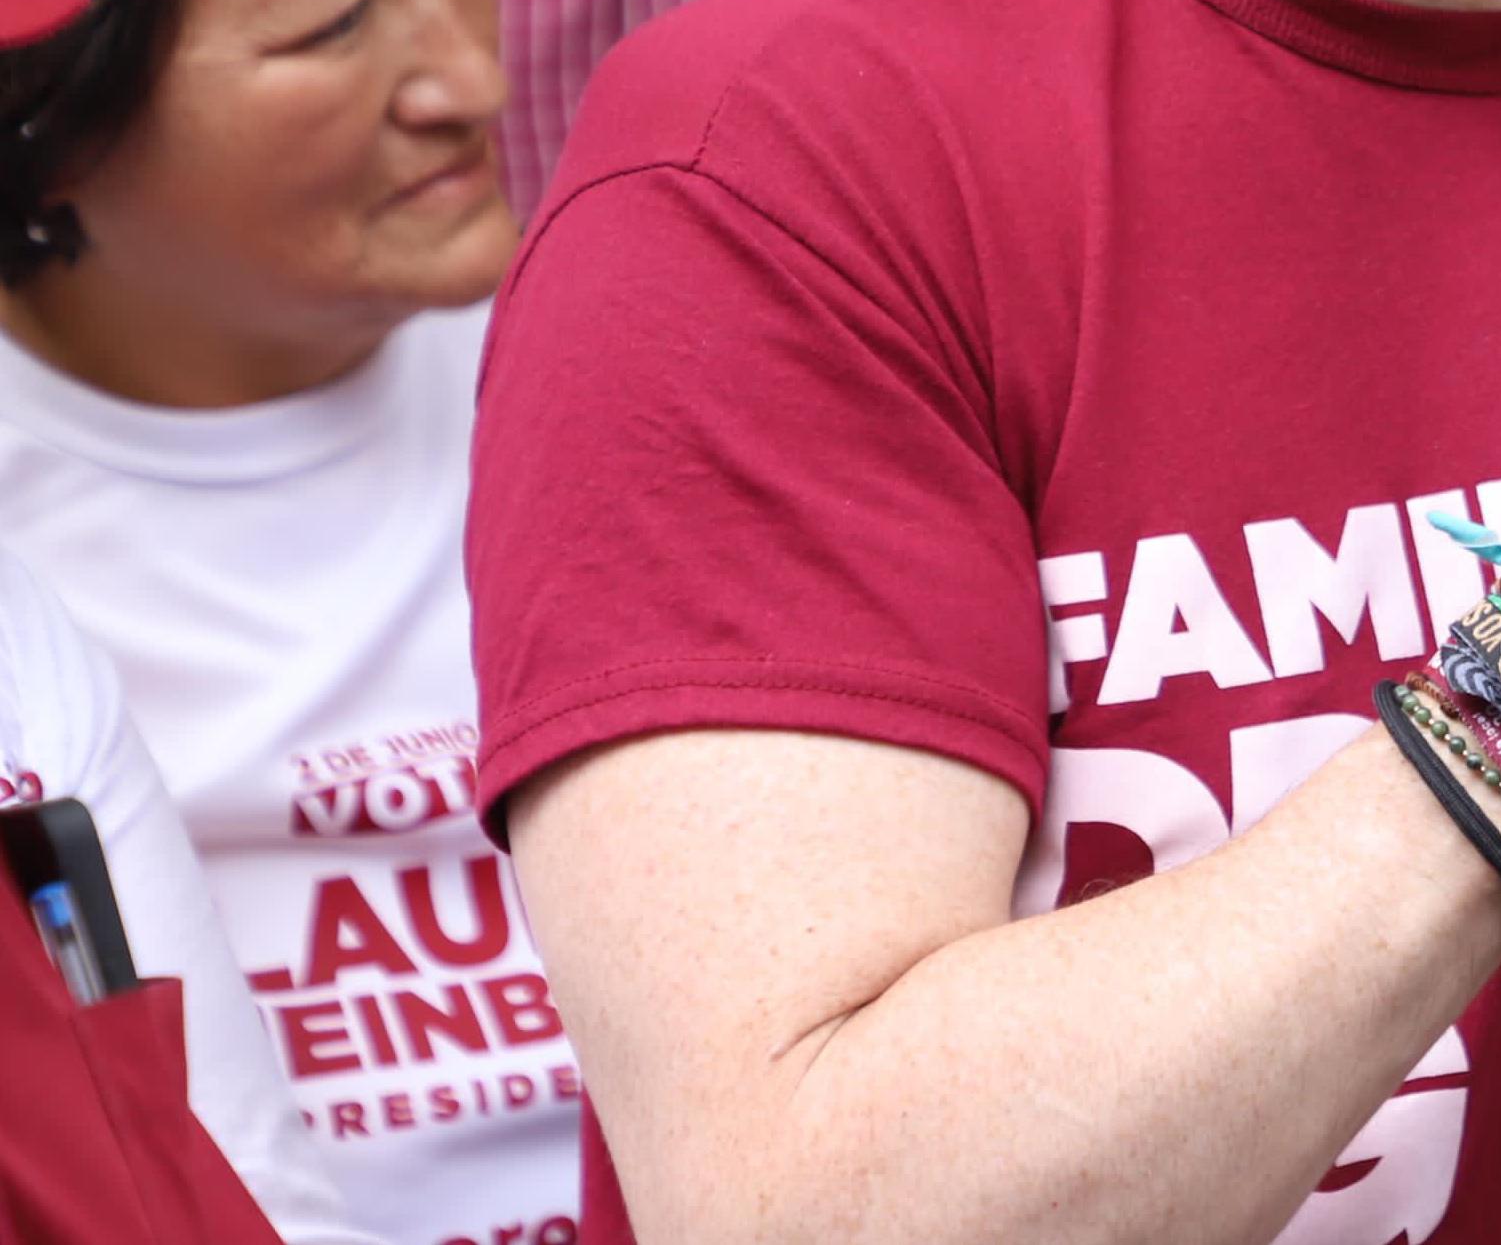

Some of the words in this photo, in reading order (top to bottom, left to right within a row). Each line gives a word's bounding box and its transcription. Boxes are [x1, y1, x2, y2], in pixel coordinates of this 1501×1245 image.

[386, 723, 478, 758] JUNIO
[248, 854, 510, 993] AU
[300, 1065, 580, 1140] RESIDE
